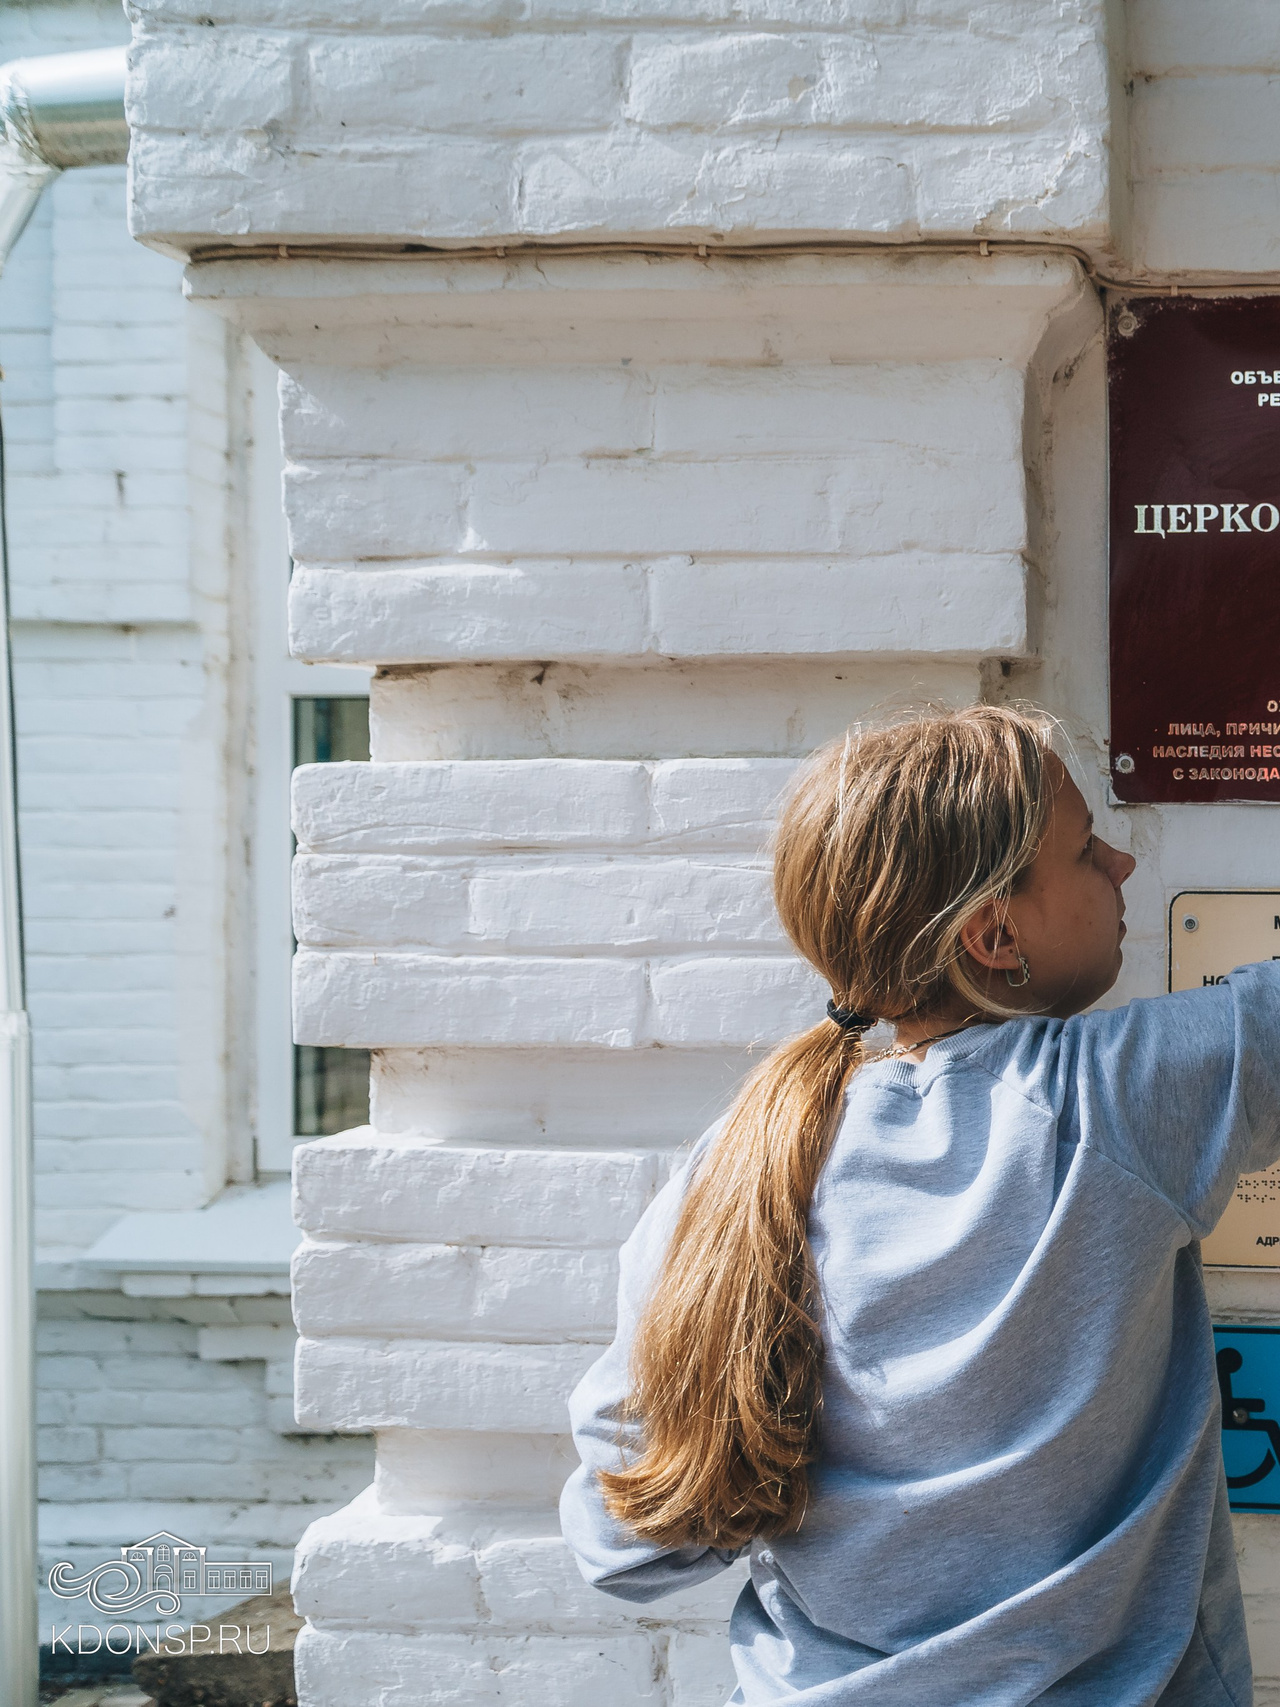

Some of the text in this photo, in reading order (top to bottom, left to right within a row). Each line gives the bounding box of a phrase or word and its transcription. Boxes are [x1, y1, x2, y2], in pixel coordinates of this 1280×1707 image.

[1167, 722, 1221, 737] ЛИЦА,
[1152, 744, 1246, 760] НАСЛЕДИЯ
[1172, 767, 1185, 781] С
